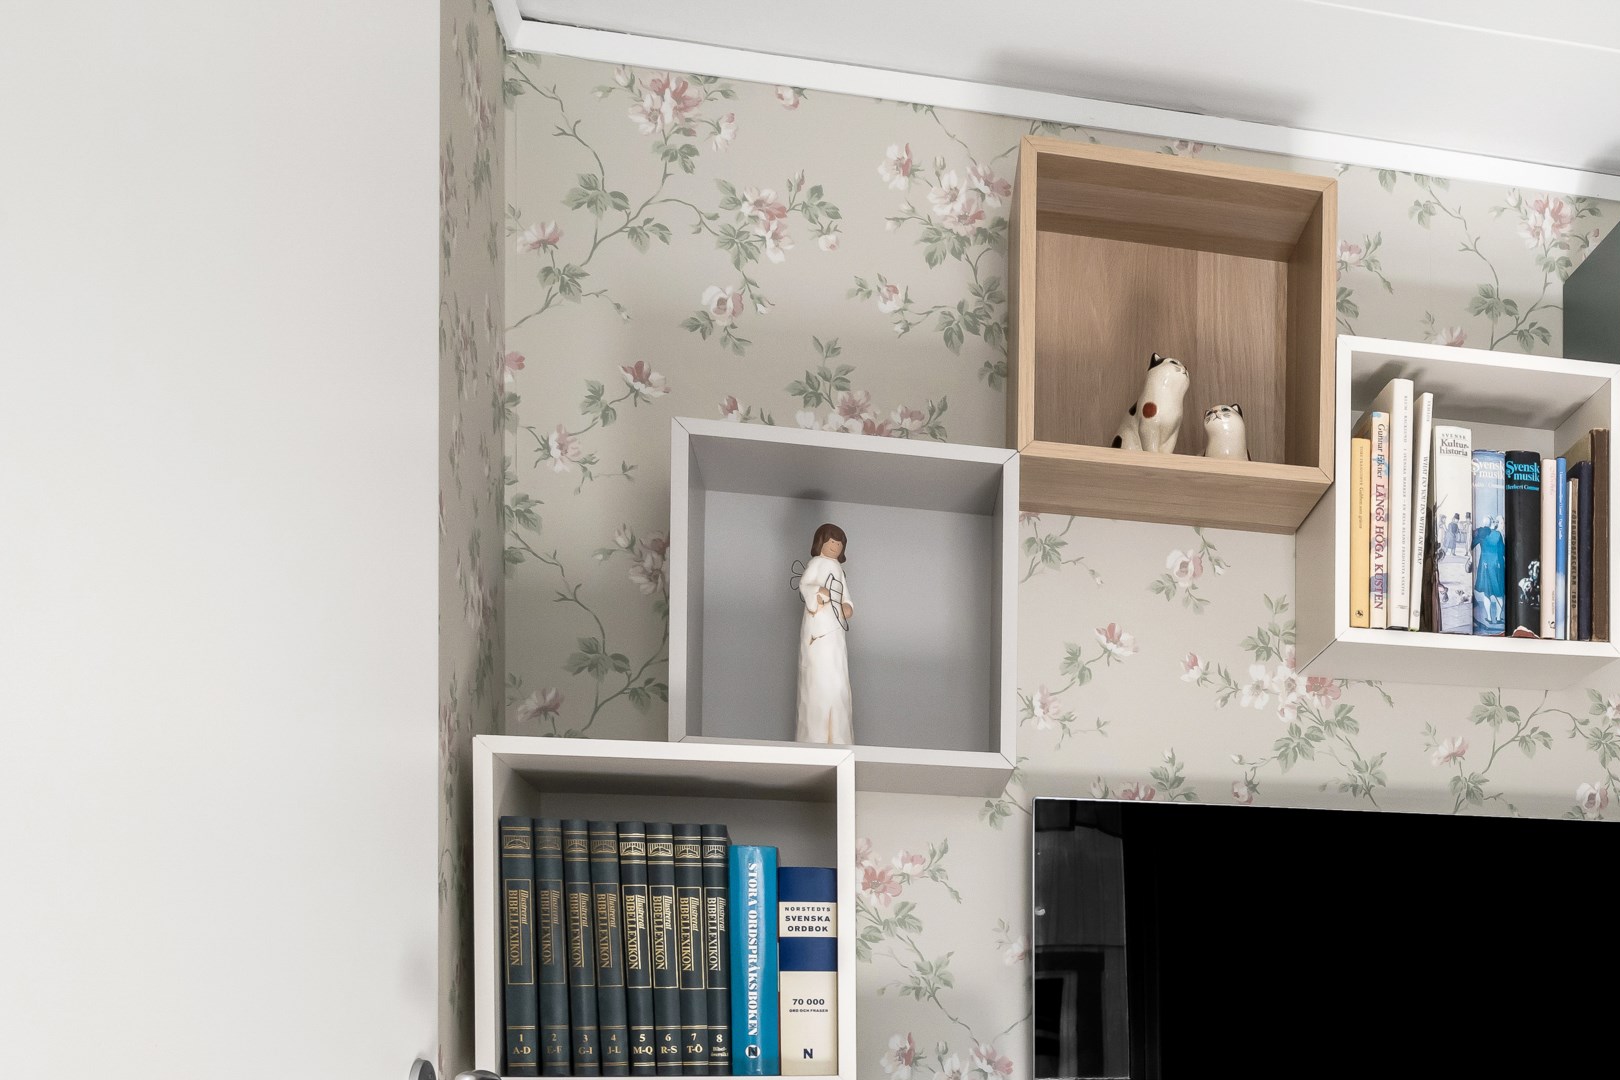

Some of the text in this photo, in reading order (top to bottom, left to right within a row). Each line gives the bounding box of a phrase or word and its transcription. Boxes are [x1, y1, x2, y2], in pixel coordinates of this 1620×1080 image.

[1440, 439, 1469, 449] Kultur-
[1439, 446, 1468, 457] historia
[1472, 458, 1505, 475] Svensk
[1505, 460, 1540, 476] Svensk
[1479, 470, 1505, 480] musik
[1513, 473, 1540, 482] musik
[1374, 423, 1387, 610] Gunnar LÄNGS HÖGA KUSTEN
[508, 889, 520, 966] BIBELLEXIKON
[569, 893, 582, 968] BIBELLEXIKON
[597, 893, 610, 969] BIBELLEXIKON
[625, 895, 639, 970] BIBELLEXIKON
[652, 895, 666, 970] BIBELLEXIKON
[787, 925, 829, 933] ORDBOK
[679, 897, 692, 972] BIBELLEXIKON
[707, 897, 719, 971] BIBELLEXIKON
[747, 863, 761, 1037] STORA ORDSPRÅKSBOKEN
[519, 1033, 523, 1042] 1
[551, 1033, 557, 1042] 2
[583, 1034, 589, 1043] 3
[610, 1034, 616, 1042] 4
[639, 1033, 646, 1042] 5
[665, 1033, 672, 1042] 6
[691, 1033, 697, 1041] 7
[716, 1034, 723, 1043] 8
[512, 1046, 532, 1055] A-D
[578, 1046, 593, 1055] G-I
[607, 1046, 621, 1054] J-L
[633, 1046, 653, 1055] M-Q
[661, 1046, 678, 1054] R-S
[686, 1043, 703, 1054] T-Ö
[803, 1048, 813, 1059] N
